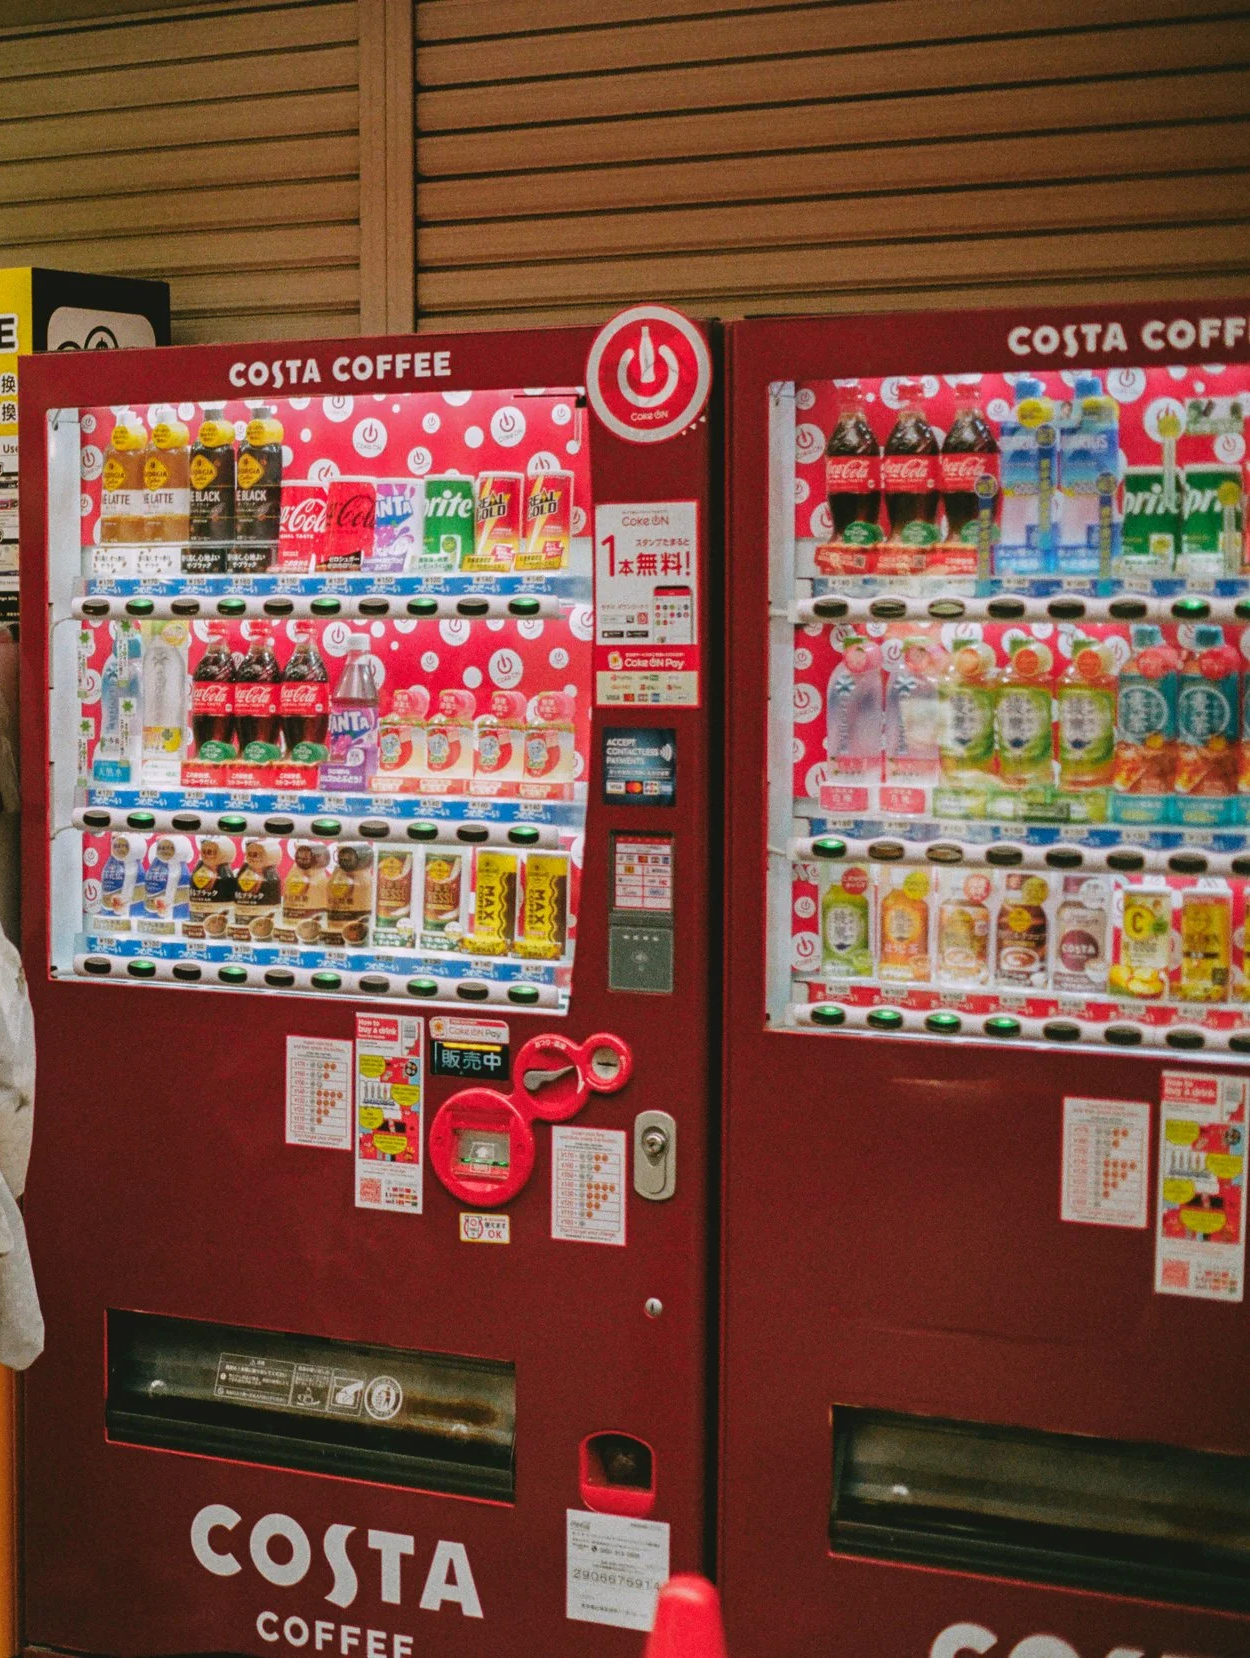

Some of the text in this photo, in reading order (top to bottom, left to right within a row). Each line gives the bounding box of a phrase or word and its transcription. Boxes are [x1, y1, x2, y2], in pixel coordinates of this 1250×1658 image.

[1008, 316, 1250, 358] COSTA COFF
[229, 351, 451, 388] COSTA COFFEE
[108, 494, 130, 505] LATTE
[151, 493, 174, 504] LATTE
[195, 491, 220, 502] BLACK
[242, 490, 267, 501] BLACK
[376, 495, 414, 518] ANTA
[622, 514, 670, 527] Coke ON
[635, 538, 690, 547] スタンプたまると
[624, 656, 685, 670] Coke ON Pay
[330, 709, 370, 732] ANTA
[607, 738, 637, 746] ACCEPT
[607, 748, 659, 756] CONTACTLESS
[607, 757, 645, 765] PAYMENTS
[485, 885, 495, 921] MAX
[534, 888, 545, 925] MAX
[442, 1049, 501, 1071] 販売中
[487, 1229, 502, 1239] OK
[190, 1504, 484, 1619] COSTA
[256, 1611, 414, 1658] COFFEE
